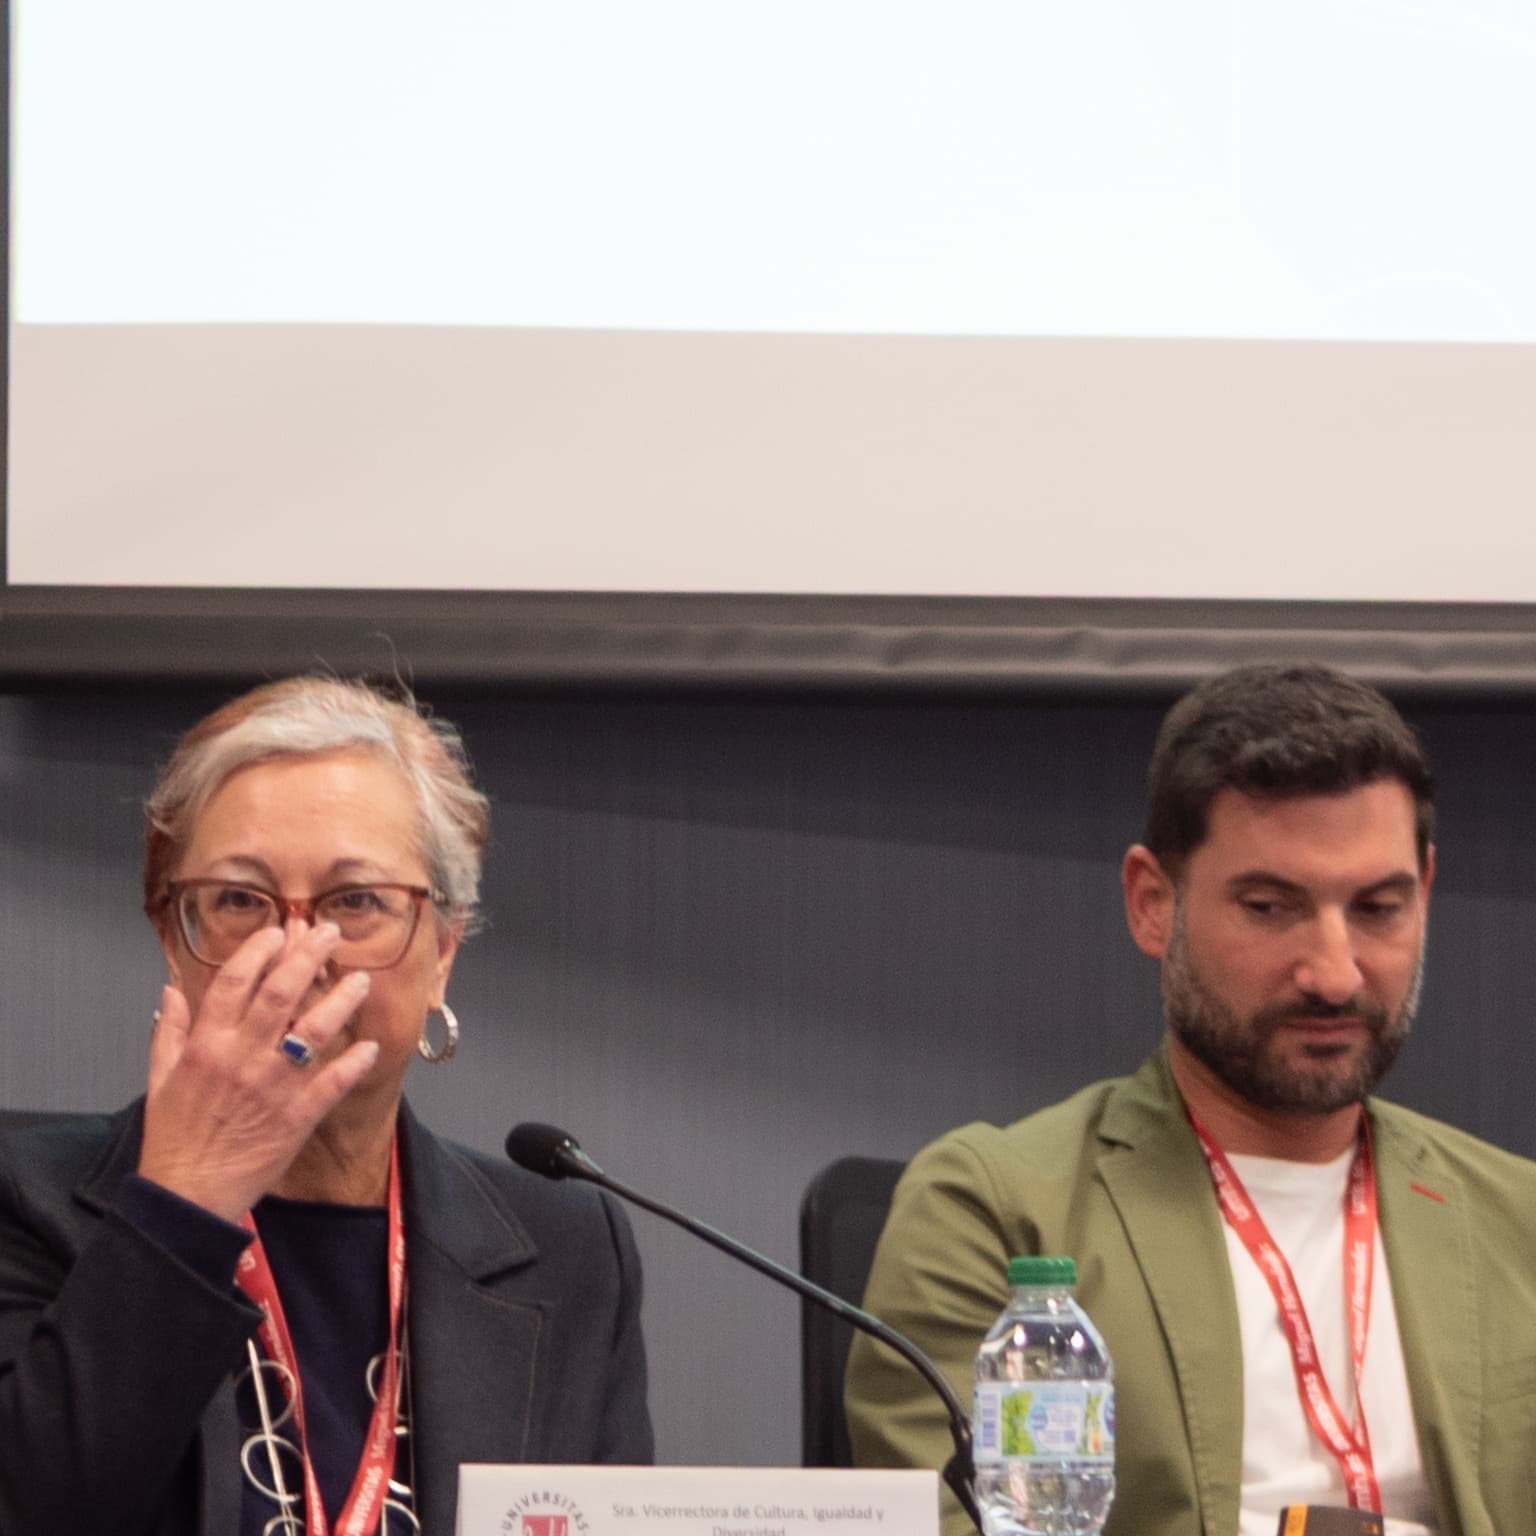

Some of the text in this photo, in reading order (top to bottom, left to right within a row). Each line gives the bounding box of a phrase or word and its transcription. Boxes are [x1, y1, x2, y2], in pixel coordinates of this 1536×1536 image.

[500, 1490, 590, 1532] UNIVERSITAS
[612, 1504, 638, 1519] Sra.
[642, 1504, 730, 1519] Vicerrectora
[732, 1504, 751, 1519] de
[754, 1504, 808, 1521] Cultura,
[876, 1509, 885, 1523] y
